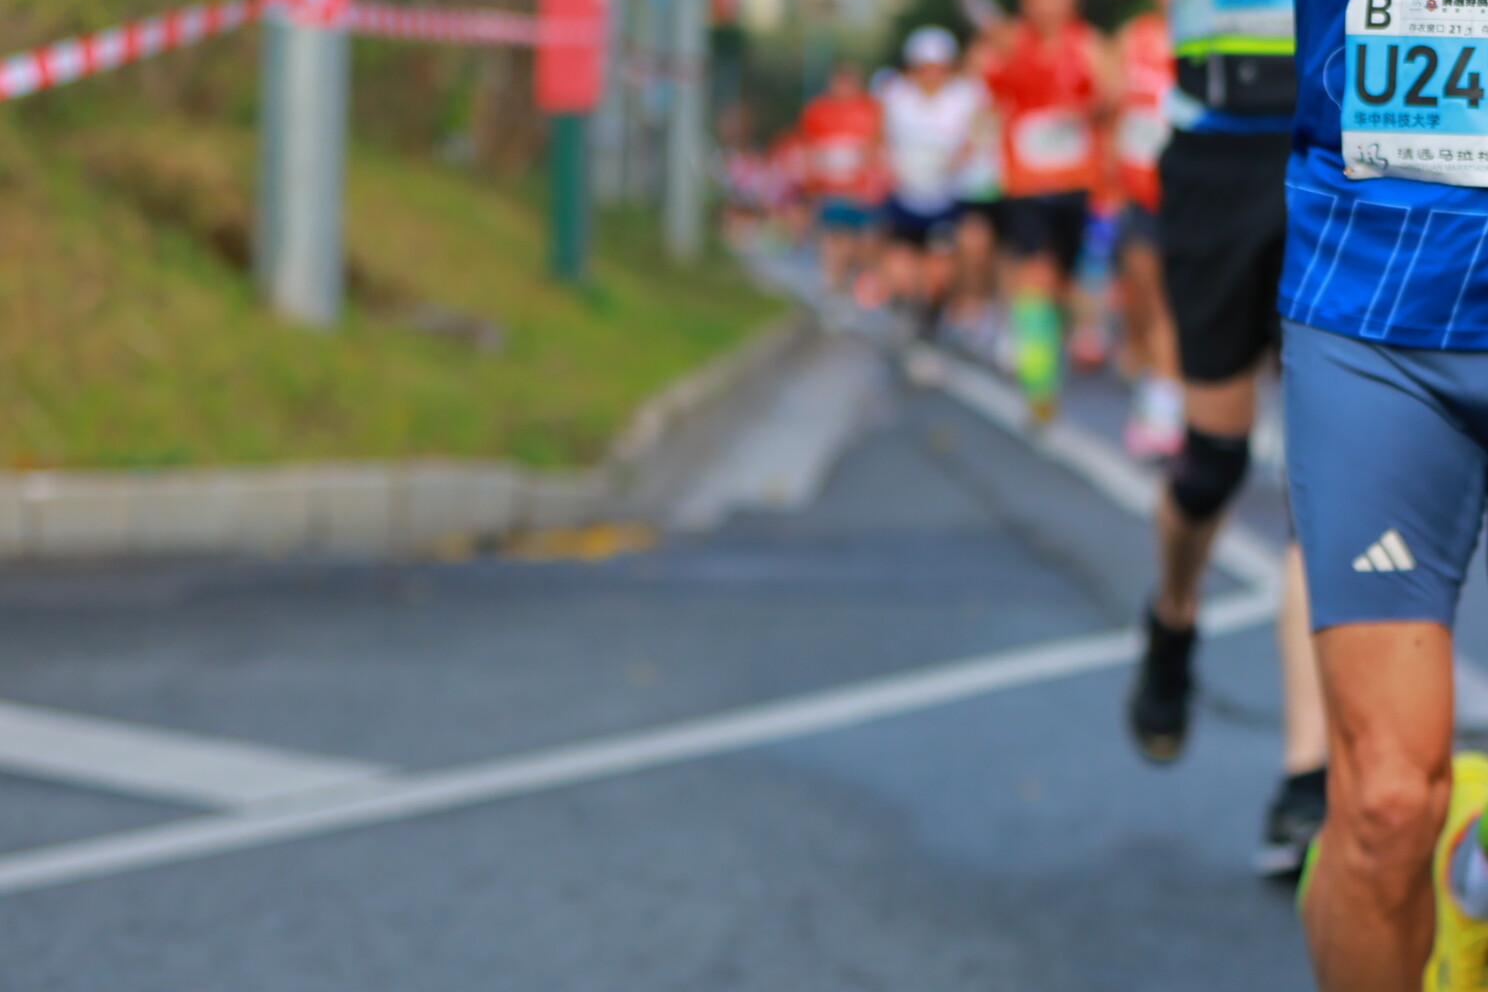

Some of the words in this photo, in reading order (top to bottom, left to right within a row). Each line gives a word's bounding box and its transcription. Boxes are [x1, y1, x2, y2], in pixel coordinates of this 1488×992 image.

[1354, 112, 1440, 128] 华中科技大学
